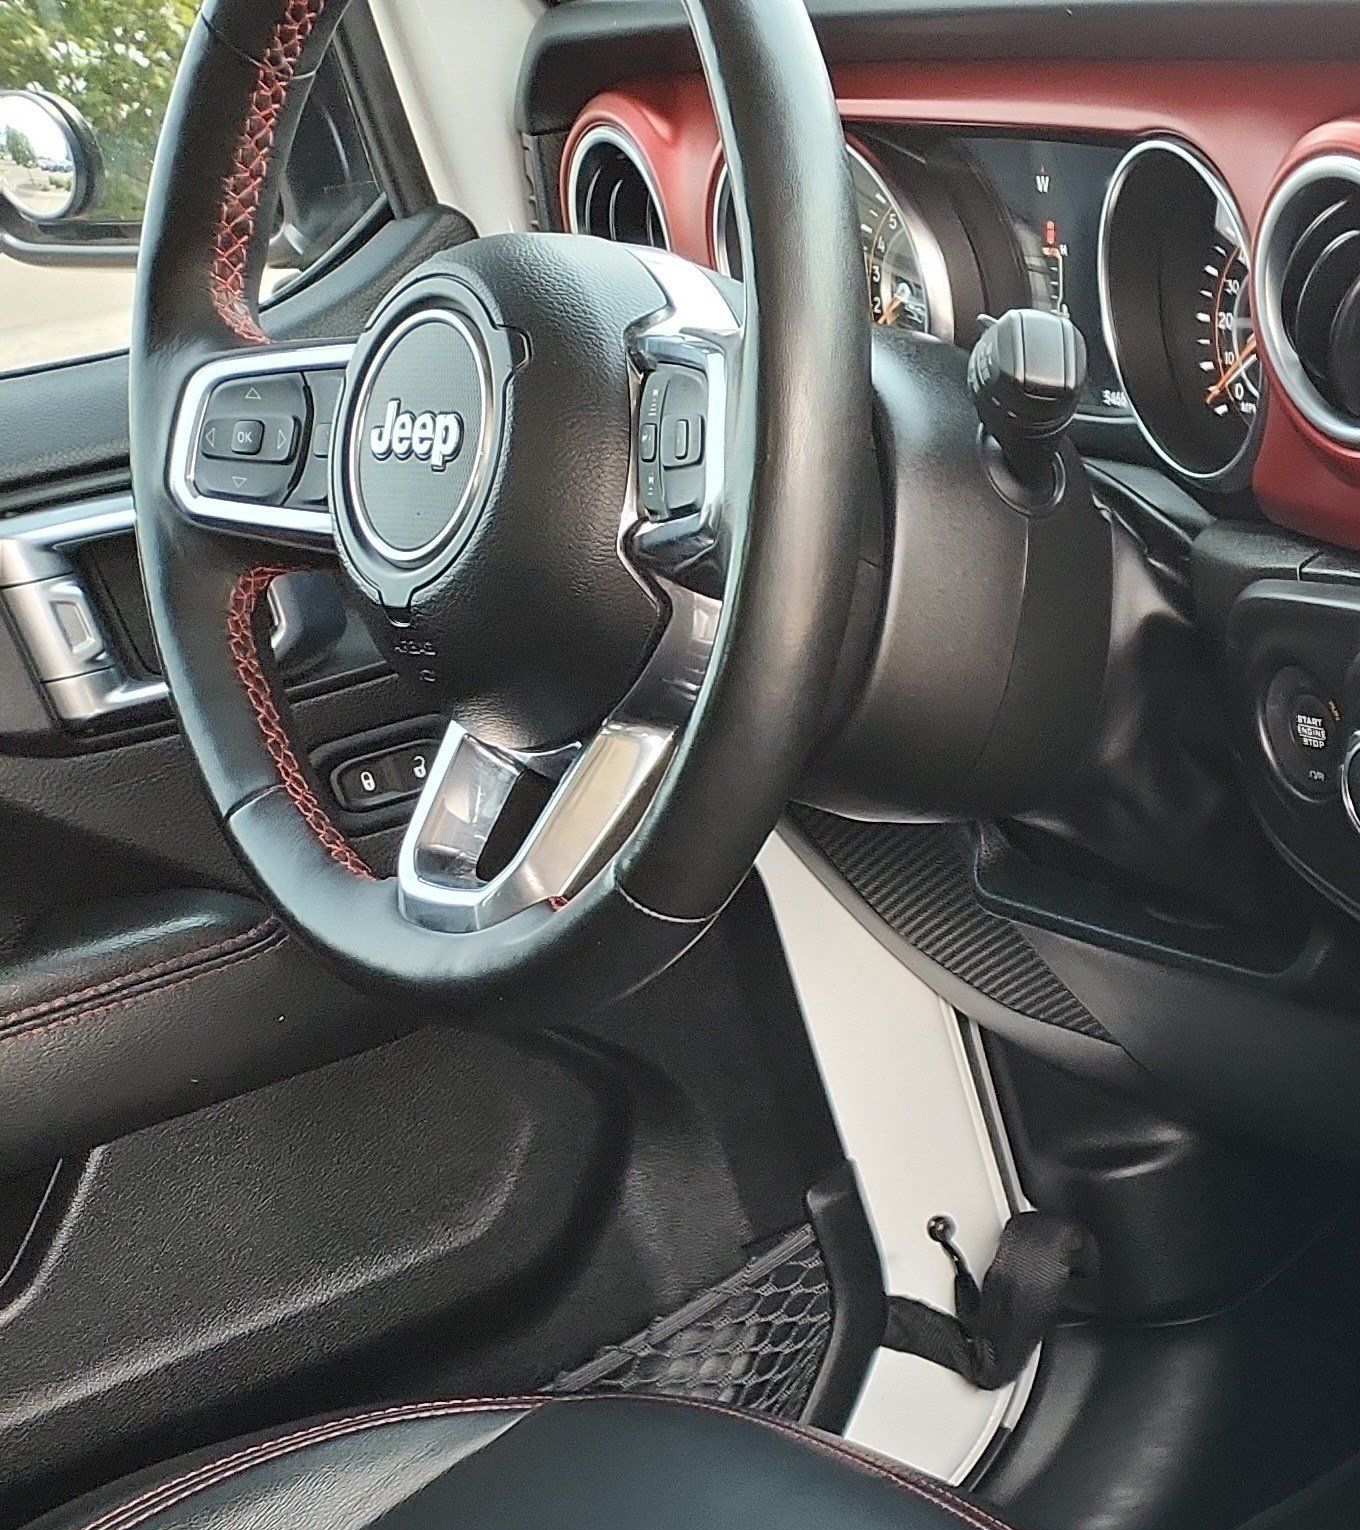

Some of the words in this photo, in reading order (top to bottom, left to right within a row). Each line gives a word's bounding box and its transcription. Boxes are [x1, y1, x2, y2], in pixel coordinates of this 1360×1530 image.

[1035, 175, 1050, 193] W
[889, 213, 898, 230] 5
[872, 265, 881, 282] 3
[1225, 279, 1240, 295] 30
[873, 296, 882, 314] 2
[1218, 312, 1232, 331] 20
[1224, 351, 1235, 365] 10
[1234, 382, 1244, 400] 0
[237, 431, 253, 443] OK
[370, 398, 465, 472] Jeep
[1297, 715, 1323, 726] START
[1303, 737, 1324, 748] STOP
